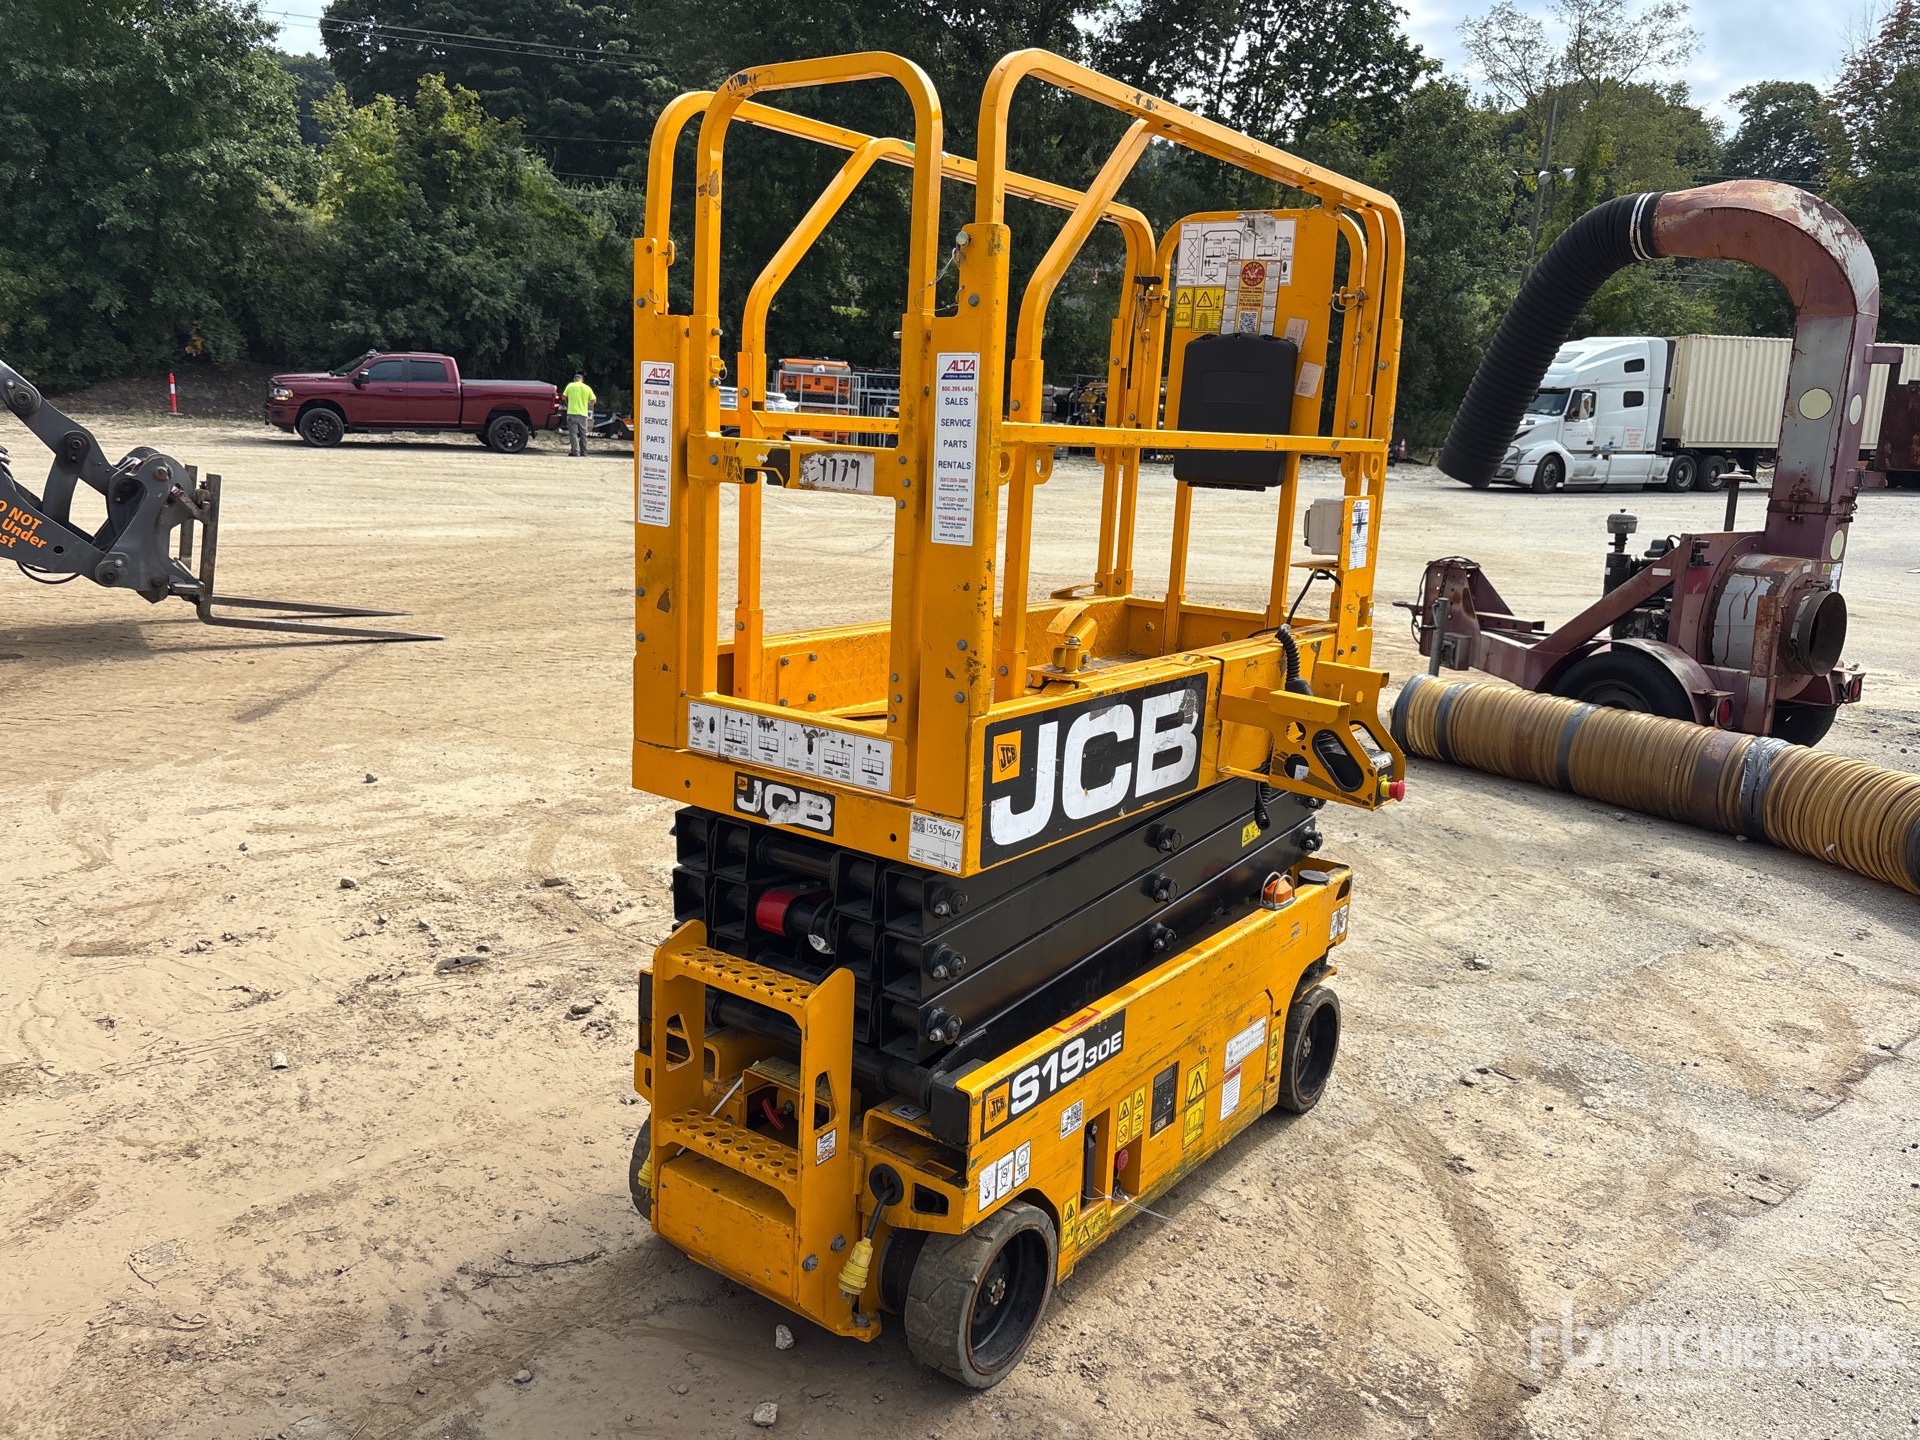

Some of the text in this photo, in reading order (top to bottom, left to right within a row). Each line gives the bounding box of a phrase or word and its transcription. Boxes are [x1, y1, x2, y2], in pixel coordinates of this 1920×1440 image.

[946, 359, 975, 372] ALTA
[648, 368, 671, 379] ALTA
[647, 399, 665, 408] SALES
[945, 397, 968, 405] SALES
[644, 417, 668, 426] SERVICE
[940, 418, 972, 427] SERVICE
[646, 435, 665, 444] PARTS
[943, 439, 968, 448] PARTS
[642, 452, 668, 462] RENTALS
[938, 460, 971, 470] RENTALS
[8, 507, 43, 530] NOT
[1, 518, 47, 548] Under
[0, 532, 17, 548] st
[1000, 745, 1017, 767] JCB
[990, 688, 1199, 846] JCB
[736, 779, 832, 831] JCB
[926, 822, 961, 840] 15596617
[990, 1096, 1007, 1120] JCB
